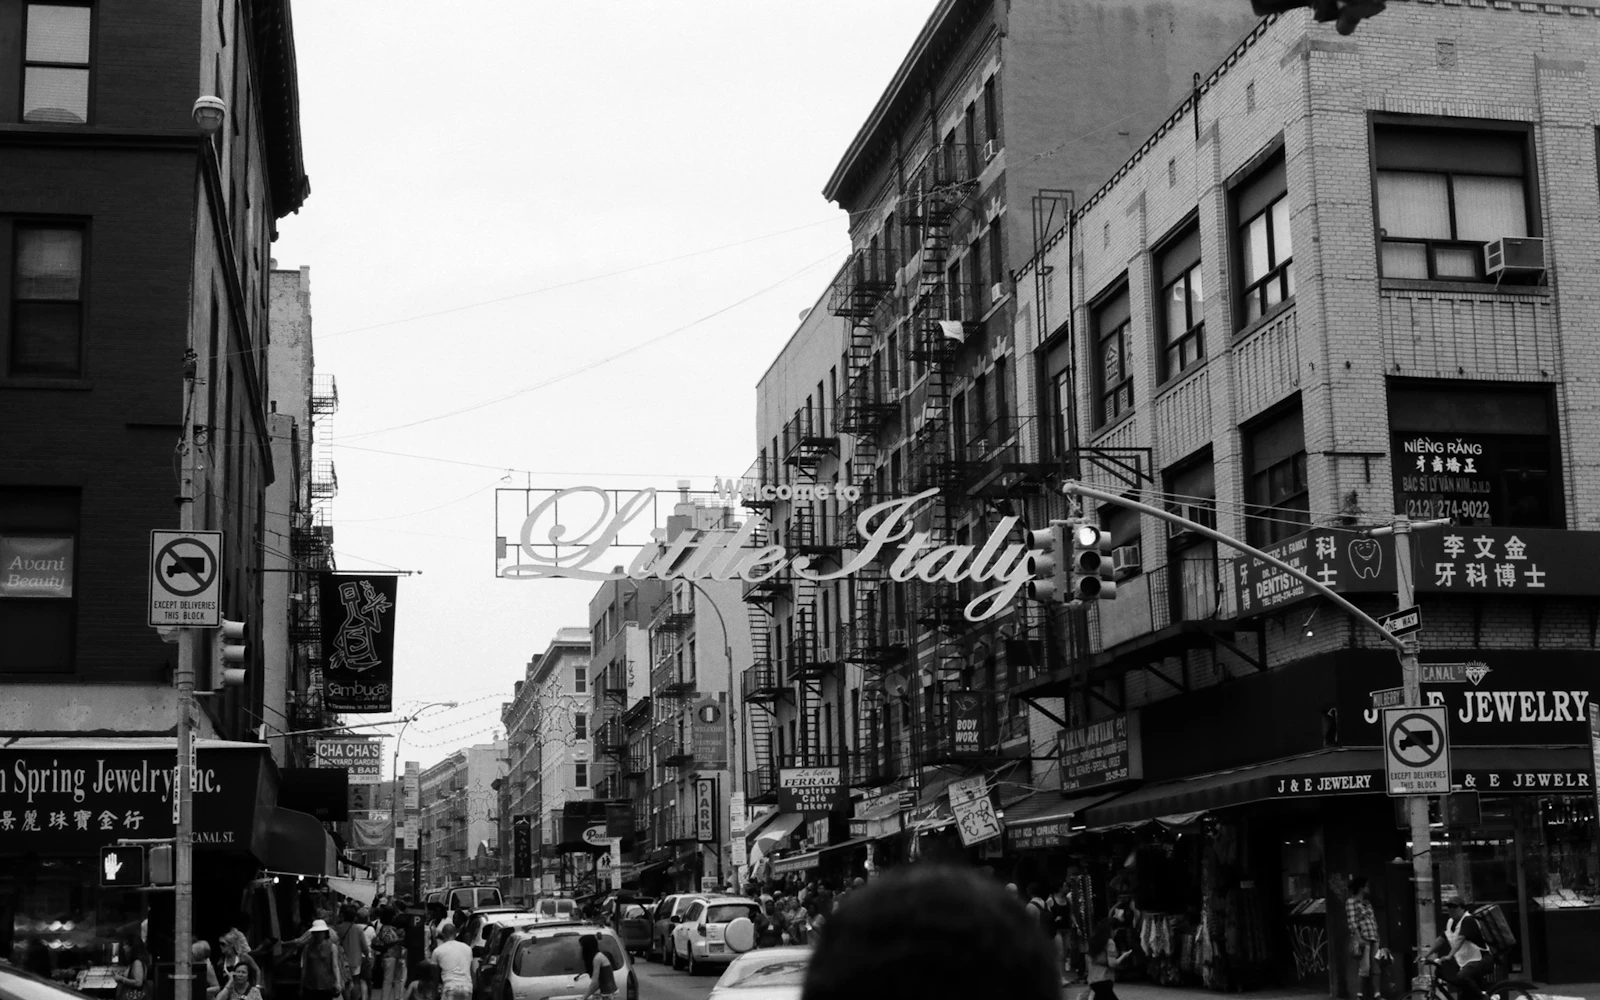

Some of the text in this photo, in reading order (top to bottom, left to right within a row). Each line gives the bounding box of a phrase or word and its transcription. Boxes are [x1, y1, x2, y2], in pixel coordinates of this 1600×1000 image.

[1447, 438, 1483, 456] RĂNG
[717, 478, 860, 501] Welcome to
[1402, 474, 1418, 492] BÁC
[1429, 474, 1438, 492] LÝ
[1438, 475, 1455, 493] VĂN
[1405, 499, 1490, 519] (212) 274-9022
[501, 485, 1040, 622] Little Italy
[1289, 537, 1308, 554] FAMILY
[1443, 534, 1527, 560] 李文金
[7, 556, 66, 571] Avani
[7, 574, 65, 591] Beauty
[1435, 562, 1546, 588] 牙科博士
[154, 601, 216, 610] EXCEPT DELIVERIES
[164, 612, 205, 620] THIS BLOCK
[1384, 614, 1416, 632] ONE WAY
[1422, 666, 1464, 681] CANAL ST
[328, 680, 390, 697] Sambuca's
[1458, 690, 1589, 723] JEWELRY
[957, 719, 977, 731] BODY
[955, 731, 979, 743] WORK
[320, 744, 379, 757] CHA CHA'S
[319, 758, 379, 766] BACKYARD GARDEN
[357, 766, 378, 774] BAR
[14, 758, 85, 803] Spring
[92, 759, 174, 802] Jewelry
[1390, 770, 1447, 781] EXCEPT DELIVERIES
[1464, 773, 1592, 787] & E JEWELR
[791, 786, 837, 795] Pastries
[1278, 775, 1372, 793] J & E JEWELRY
[1400, 780, 1437, 789] THIS BLOCK
[700, 783, 710, 830] PARK
[796, 802, 834, 811] Bakery
[802, 794, 827, 803] Café
[0, 810, 144, 831] 景麗珠寶金行
[190, 831, 235, 844] CANAL ST.
[518, 829, 528, 873] NAPOLI
[414, 916, 421, 926] P
